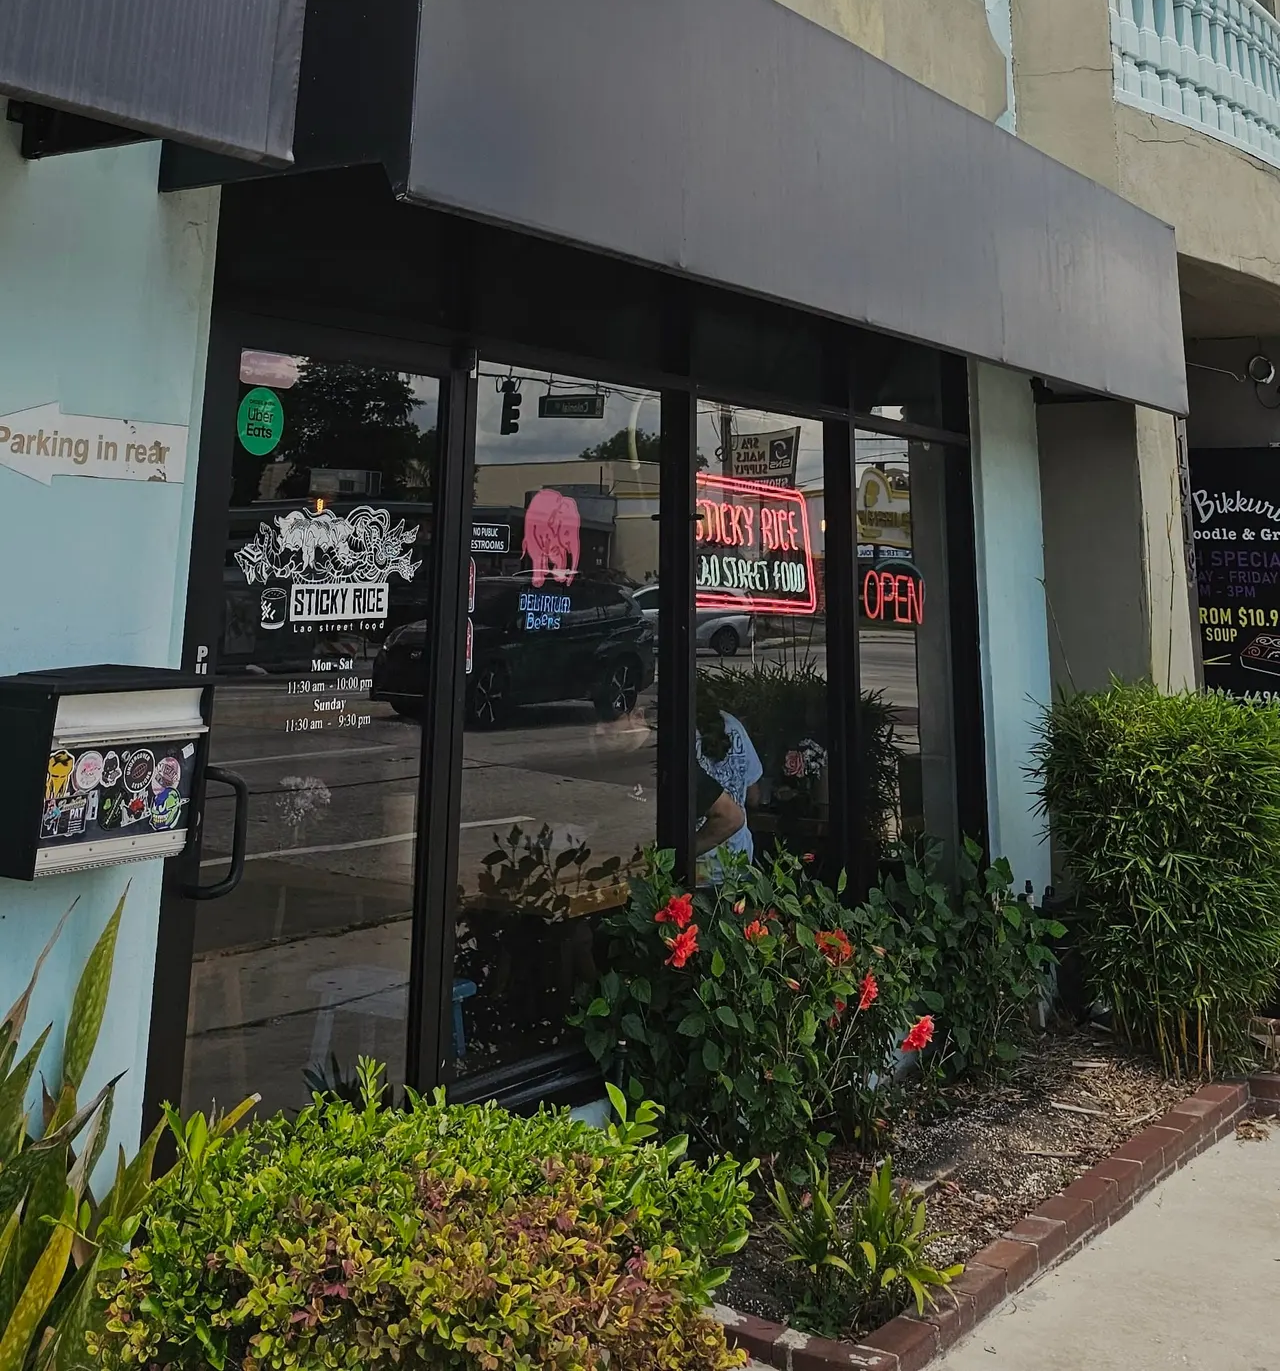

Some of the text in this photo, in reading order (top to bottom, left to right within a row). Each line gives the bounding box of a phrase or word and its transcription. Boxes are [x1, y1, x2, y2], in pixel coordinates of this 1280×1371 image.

[247, 407, 274, 423] Uber
[246, 423, 273, 438] Eats
[96, 434, 118, 462] in
[125, 440, 171, 465] rear
[472, 527, 499, 537] NO PUBLIC
[760, 507, 799, 551] RICE
[1193, 527, 1237, 540] oodle
[1242, 528, 1256, 541] &
[470, 539, 504, 550] ESTROOMS
[696, 554, 806, 593] AO STREET FOOD
[1229, 570, 1279, 584] FRIDAY
[863, 569, 924, 625] OPEN
[1227, 585, 1256, 598] 3PM
[294, 587, 385, 616] STICKY RICE
[519, 593, 571, 613] DELIRIUM
[526, 612, 561, 630] Beers
[1199, 607, 1232, 625] ROM
[293, 619, 385, 633] Lao street food
[1206, 627, 1238, 642] SOUP
[311, 659, 332, 672] Mon
[339, 657, 353, 670] Sat
[287, 680, 311, 694] 11:30
[312, 682, 325, 692] am
[336, 676, 359, 690] 10:00
[359, 678, 373, 691] pm
[313, 697, 347, 713] Sunday
[285, 717, 309, 732] 11:30
[310, 719, 323, 730] am
[338, 713, 357, 728] 9:30
[357, 715, 371, 729] pm
[70, 808, 84, 819] PAT
